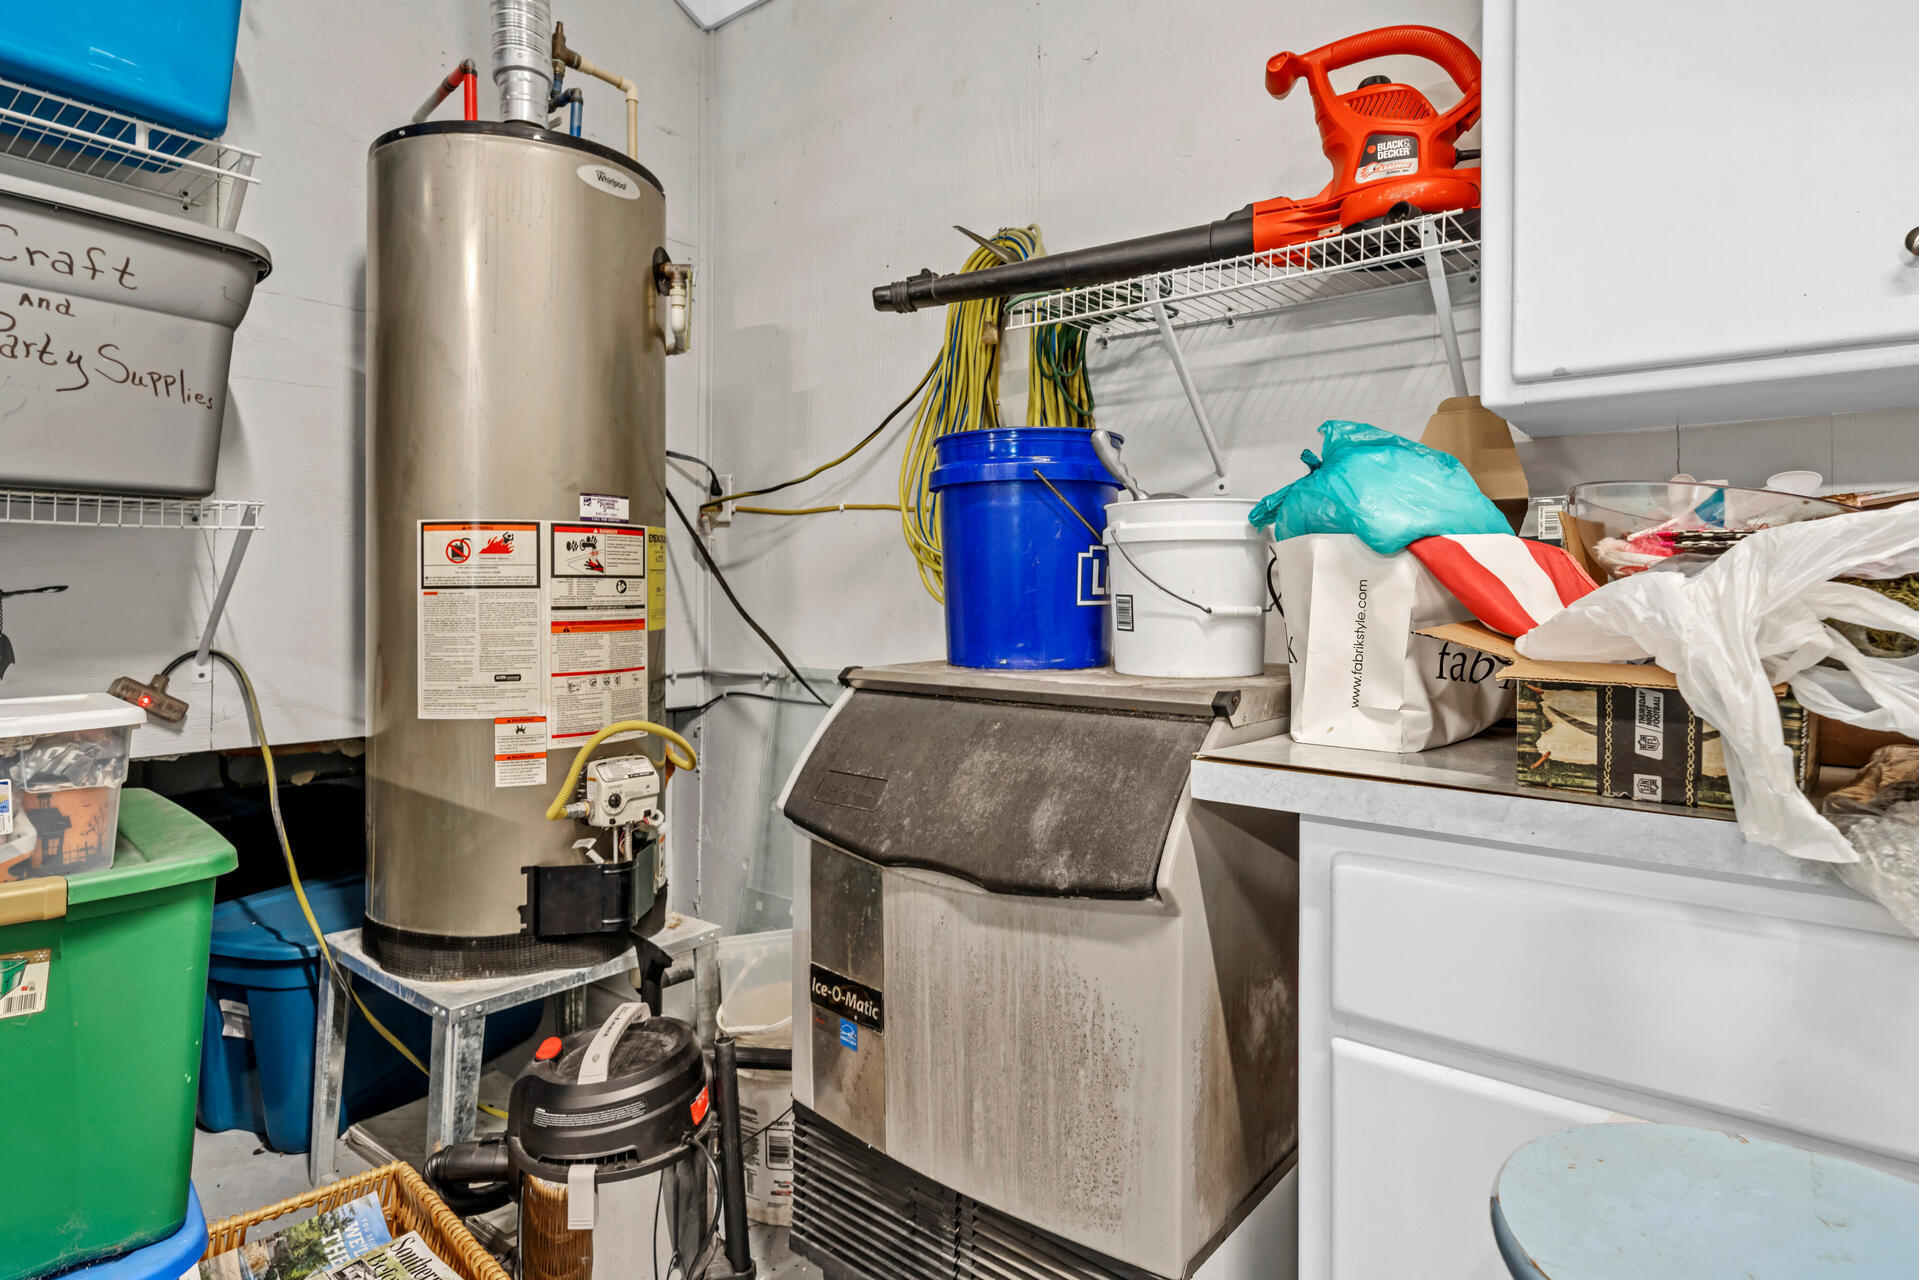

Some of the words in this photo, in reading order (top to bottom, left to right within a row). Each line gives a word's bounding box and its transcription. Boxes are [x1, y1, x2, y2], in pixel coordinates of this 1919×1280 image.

[1377, 138, 1410, 152] BLACK&
[1377, 148, 1410, 160] DECKER
[596, 172, 627, 191] Whirlpool
[0, 224, 138, 290] Craft
[94, 343, 214, 410] Supplies
[1351, 579, 1368, 709] www.fabrikstyle.com
[1638, 691, 1646, 724] THURSDAY
[1645, 706, 1653, 726] NIGHT
[1652, 696, 1661, 728] FOOTBALL
[811, 977, 879, 1020] Ice-O-Matic
